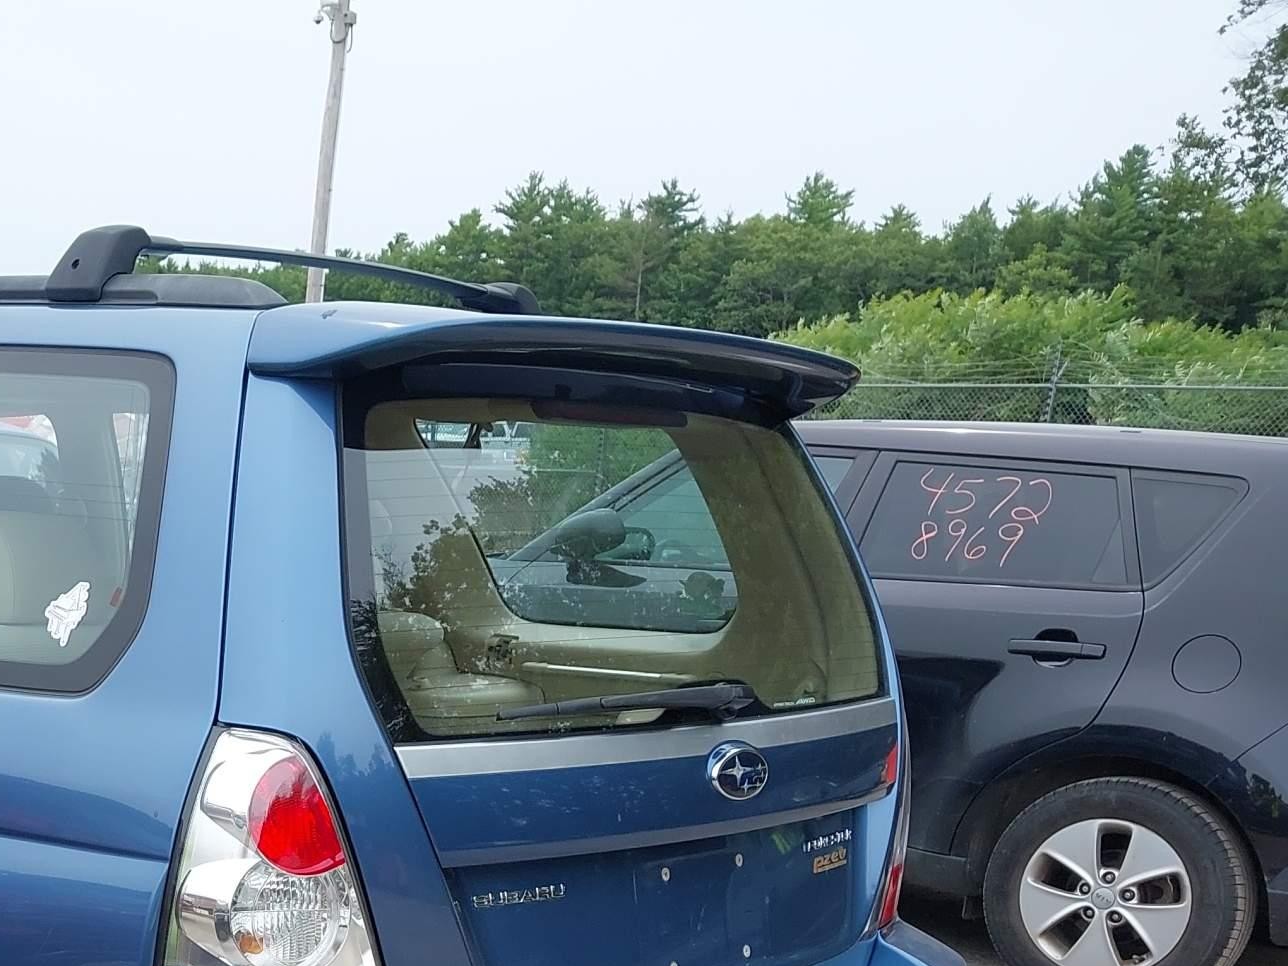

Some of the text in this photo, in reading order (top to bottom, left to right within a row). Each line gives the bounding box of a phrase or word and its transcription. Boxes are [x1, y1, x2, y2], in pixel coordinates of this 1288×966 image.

[920, 468, 1053, 525] 4572
[911, 518, 1024, 568] 8969
[472, 883, 566, 908] SUBARU
